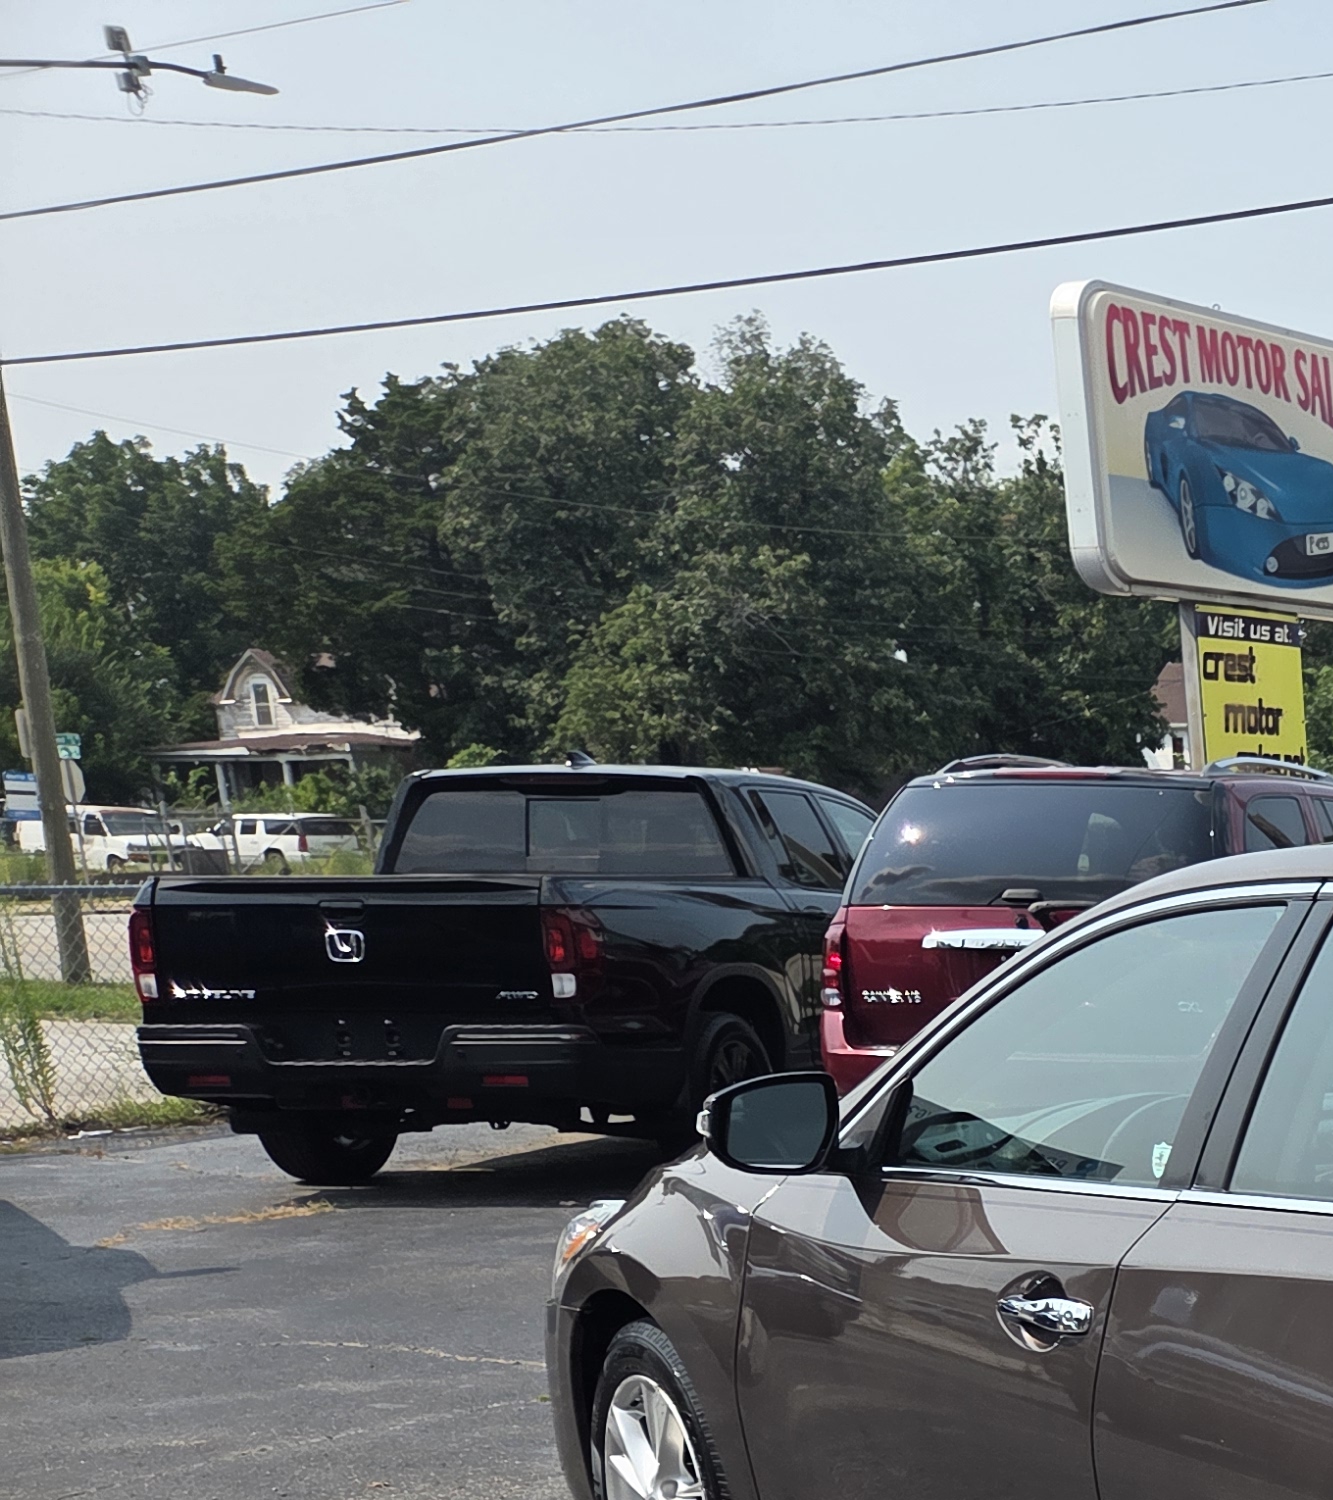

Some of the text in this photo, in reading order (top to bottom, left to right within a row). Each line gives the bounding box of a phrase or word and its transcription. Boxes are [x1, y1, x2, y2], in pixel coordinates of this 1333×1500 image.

[1106, 303, 1191, 405] CREST
[1197, 325, 1292, 403] MOTOR
[1207, 615, 1246, 638] Visit
[1250, 623, 1271, 641] us
[1203, 646, 1256, 684] crest
[1224, 698, 1283, 736] motor
